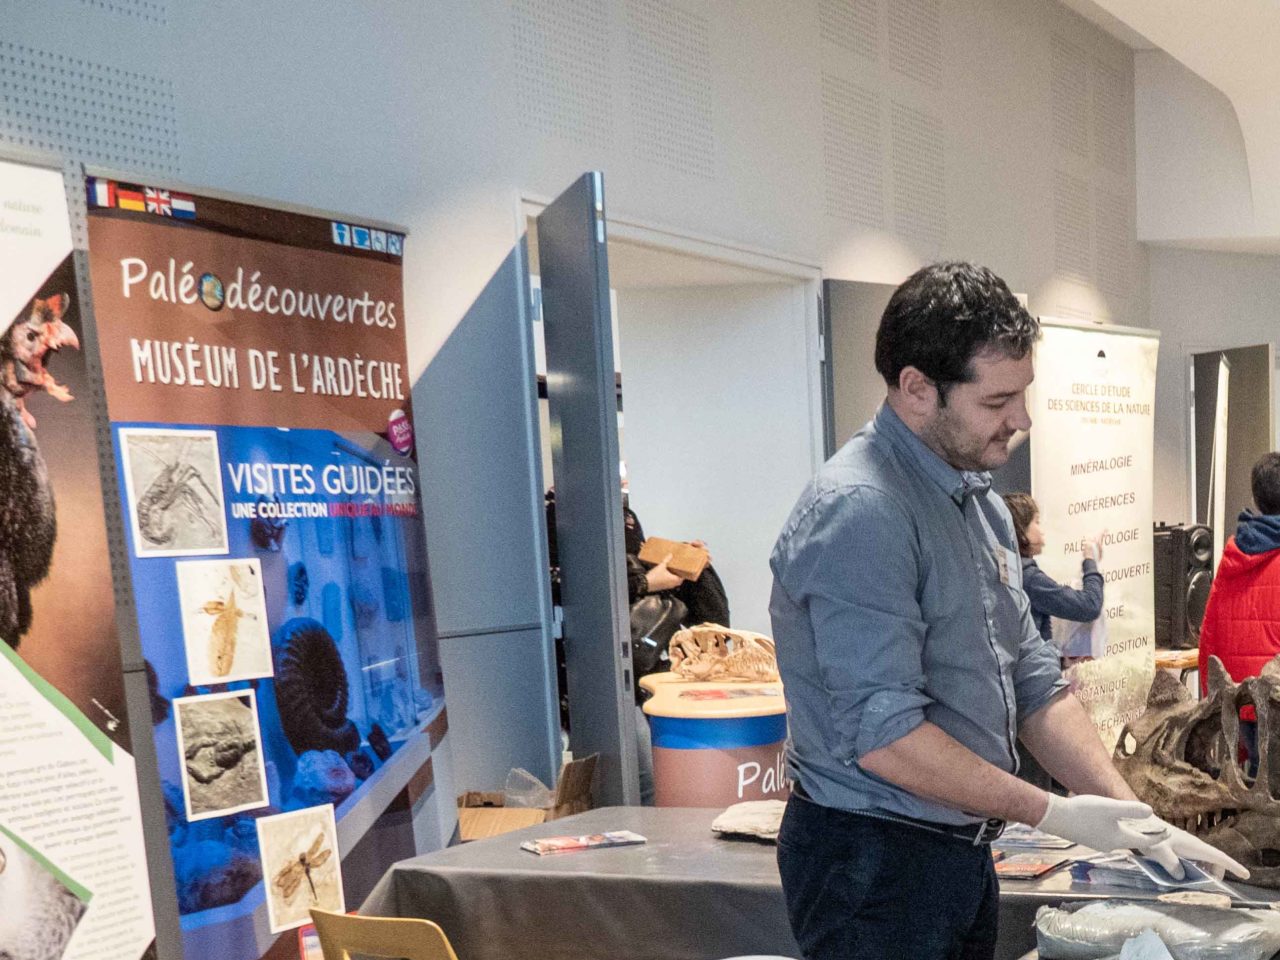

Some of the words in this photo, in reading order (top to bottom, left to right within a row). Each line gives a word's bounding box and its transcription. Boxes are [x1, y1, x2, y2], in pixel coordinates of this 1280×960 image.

[130, 337, 240, 389] MUSÉUM
[249, 348, 283, 392] DE
[290, 353, 405, 400] L'ARDÈCHE
[1071, 382, 1099, 396] CERCLE
[1048, 398, 1064, 411] DES
[1065, 399, 1100, 413] SCIENCES
[1101, 401, 1112, 413] DE
[1113, 403, 1124, 415] LA
[1126, 403, 1151, 416] NATURE
[1070, 455, 1133, 476] MINÉRALOGIE
[227, 462, 316, 495] VISITES
[322, 459, 416, 495] GUIDÉES
[231, 502, 257, 519] UNE
[258, 502, 328, 518] COLLECTION
[1068, 492, 1136, 516] CONFÉRENCES
